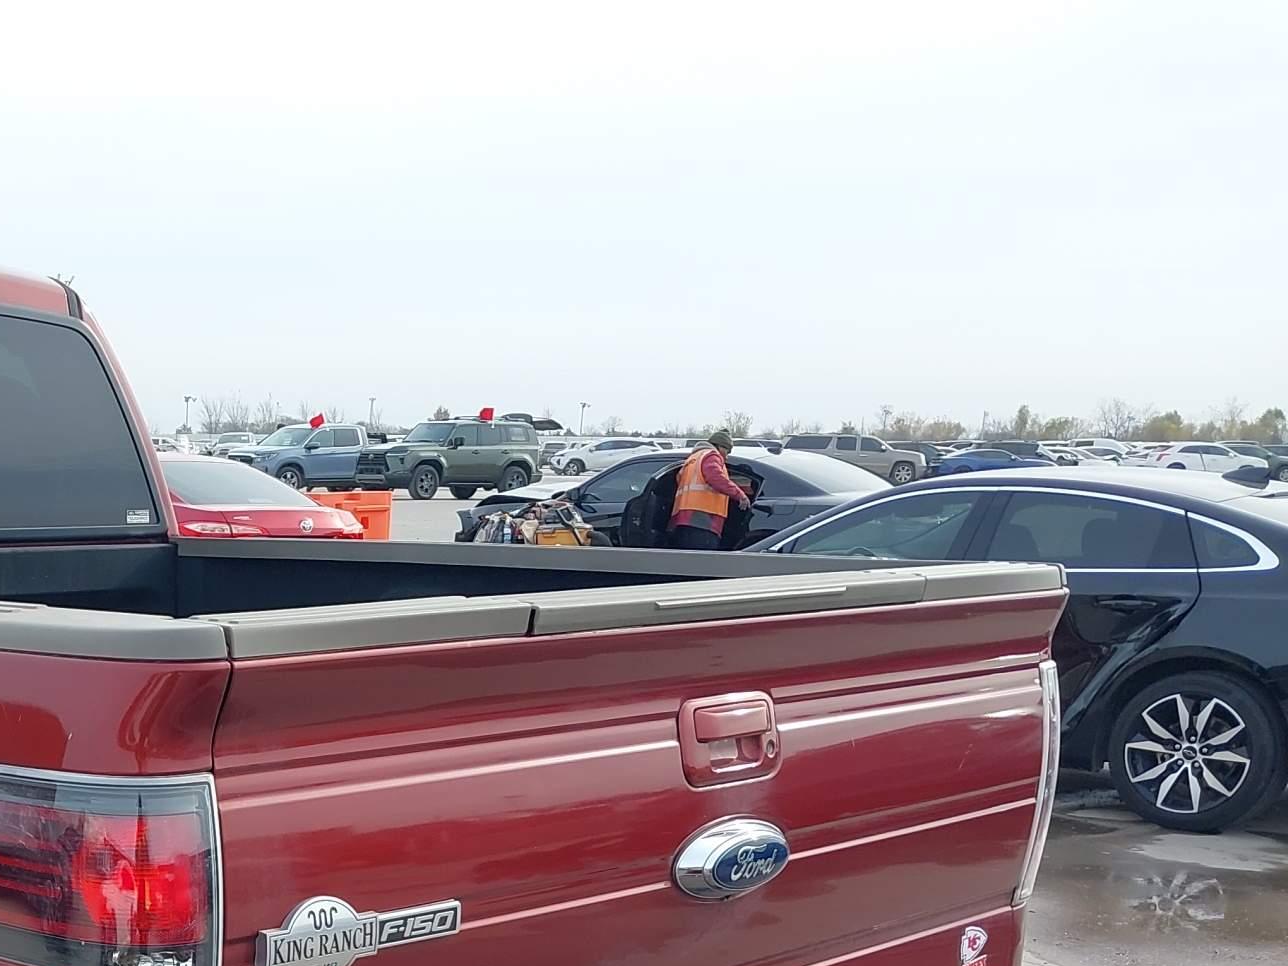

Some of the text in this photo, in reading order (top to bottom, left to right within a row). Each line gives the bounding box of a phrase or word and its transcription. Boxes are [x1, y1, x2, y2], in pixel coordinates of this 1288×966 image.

[730, 843, 778, 881] Ford
[273, 921, 374, 966] KING RANCH
[379, 910, 454, 942] F-150
